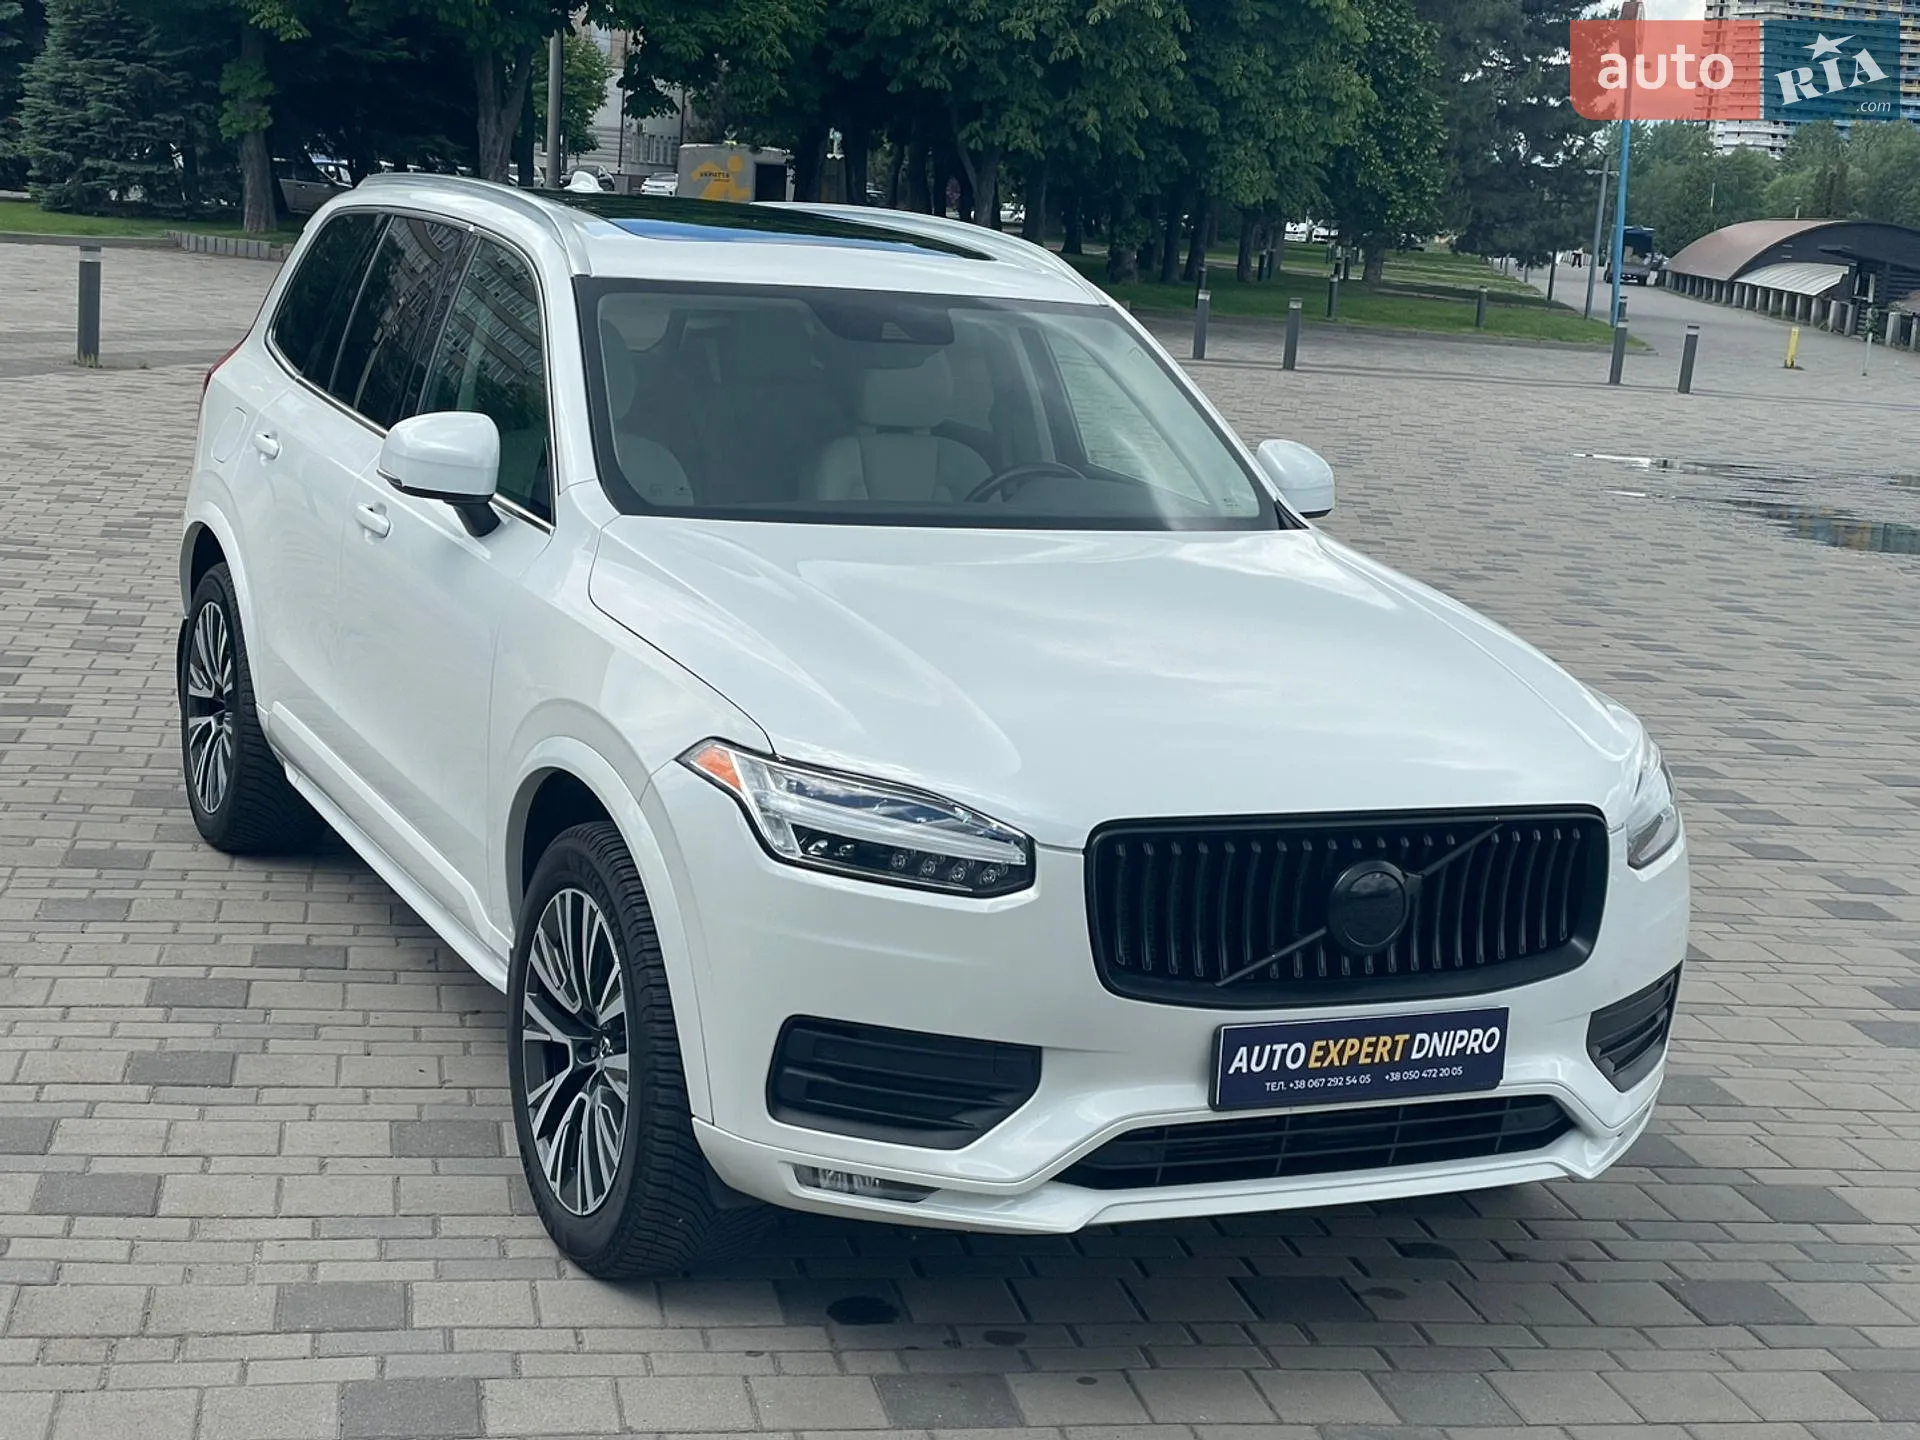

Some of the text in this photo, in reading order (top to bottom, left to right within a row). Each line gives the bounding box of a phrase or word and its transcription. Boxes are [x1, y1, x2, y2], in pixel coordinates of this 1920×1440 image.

[1228, 1026, 1502, 1075] AUTO EXPERT DNIPRO
[1265, 1066, 1463, 1092] ТЕЛ. +38 067 292 54 05 +38 050 472 20 05
